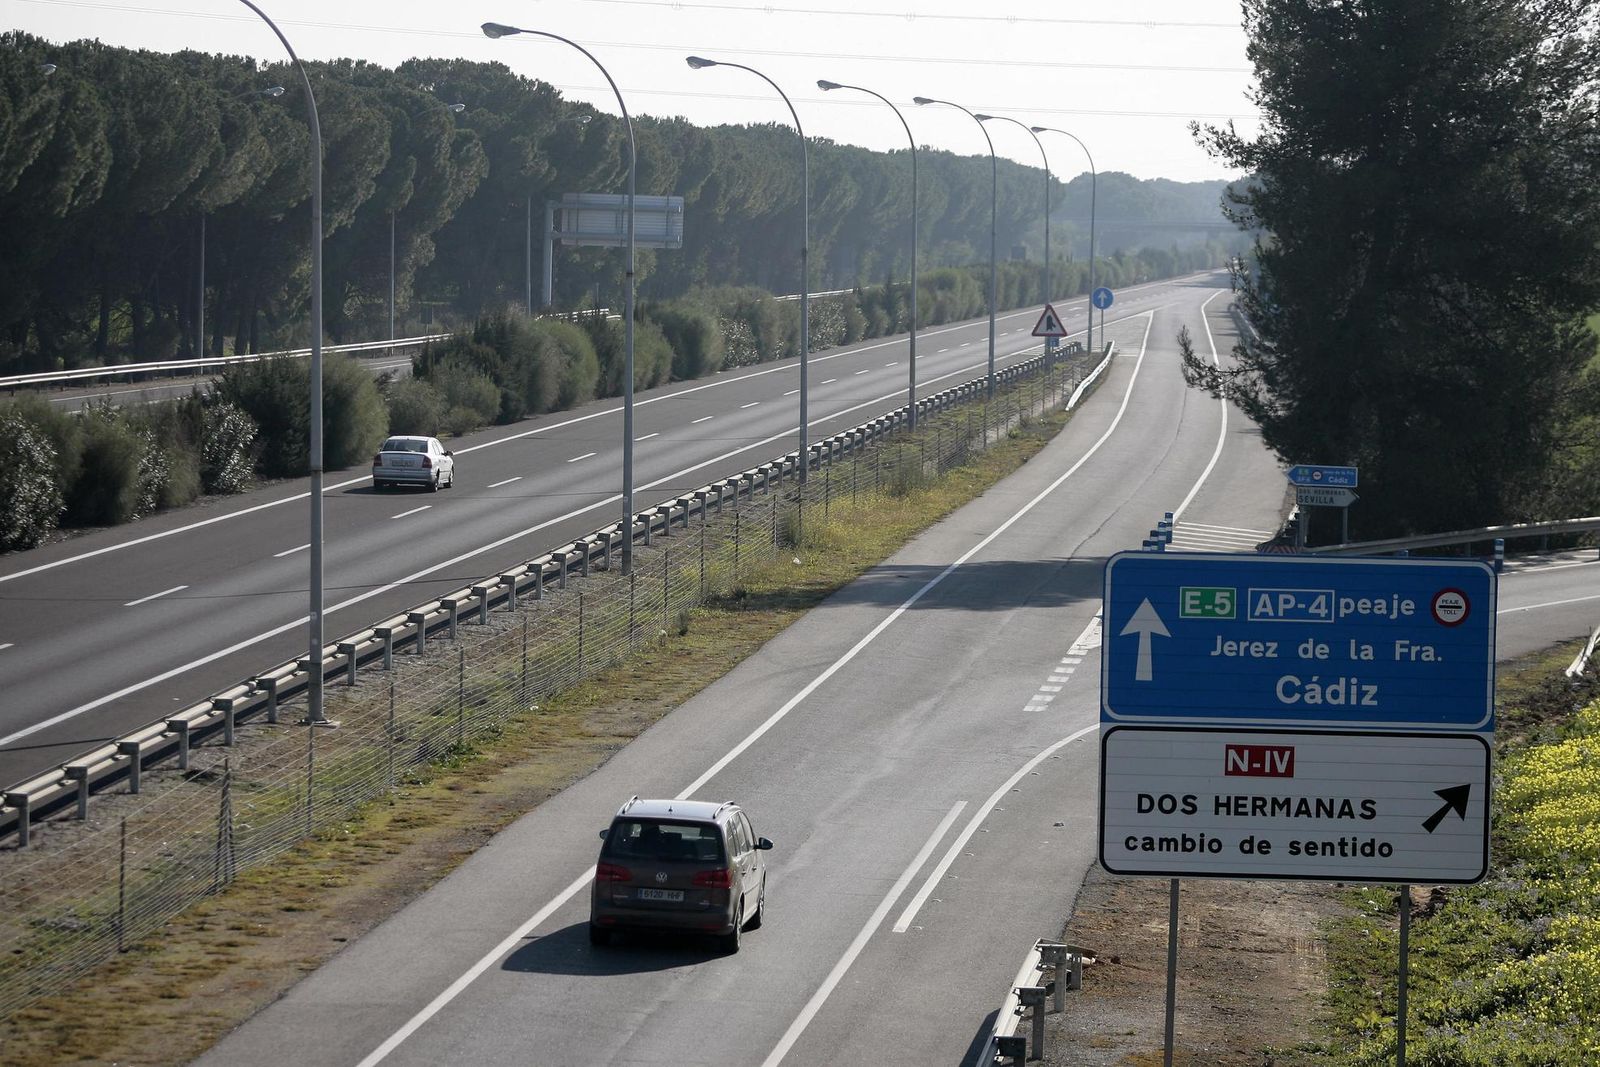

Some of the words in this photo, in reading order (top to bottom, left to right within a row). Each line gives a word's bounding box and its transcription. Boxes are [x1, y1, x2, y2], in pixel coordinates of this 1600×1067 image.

[1299, 496, 1334, 504] SEVILLA
[1185, 592, 1232, 615] E-5
[1254, 594, 1329, 618] AP-4
[1340, 594, 1416, 619] peaje
[1210, 636, 1278, 658] Jerez
[1298, 639, 1329, 660] de
[1351, 640, 1374, 661] la
[1395, 641, 1442, 662] Fra.
[1276, 675, 1378, 705] Cádiz
[1227, 749, 1291, 772] N-IV
[1138, 794, 1198, 814] DOS
[1214, 796, 1377, 819] HERMANAS
[1124, 833, 1223, 852] cambio
[1239, 835, 1271, 854] de
[1289, 837, 1393, 857] sentido
